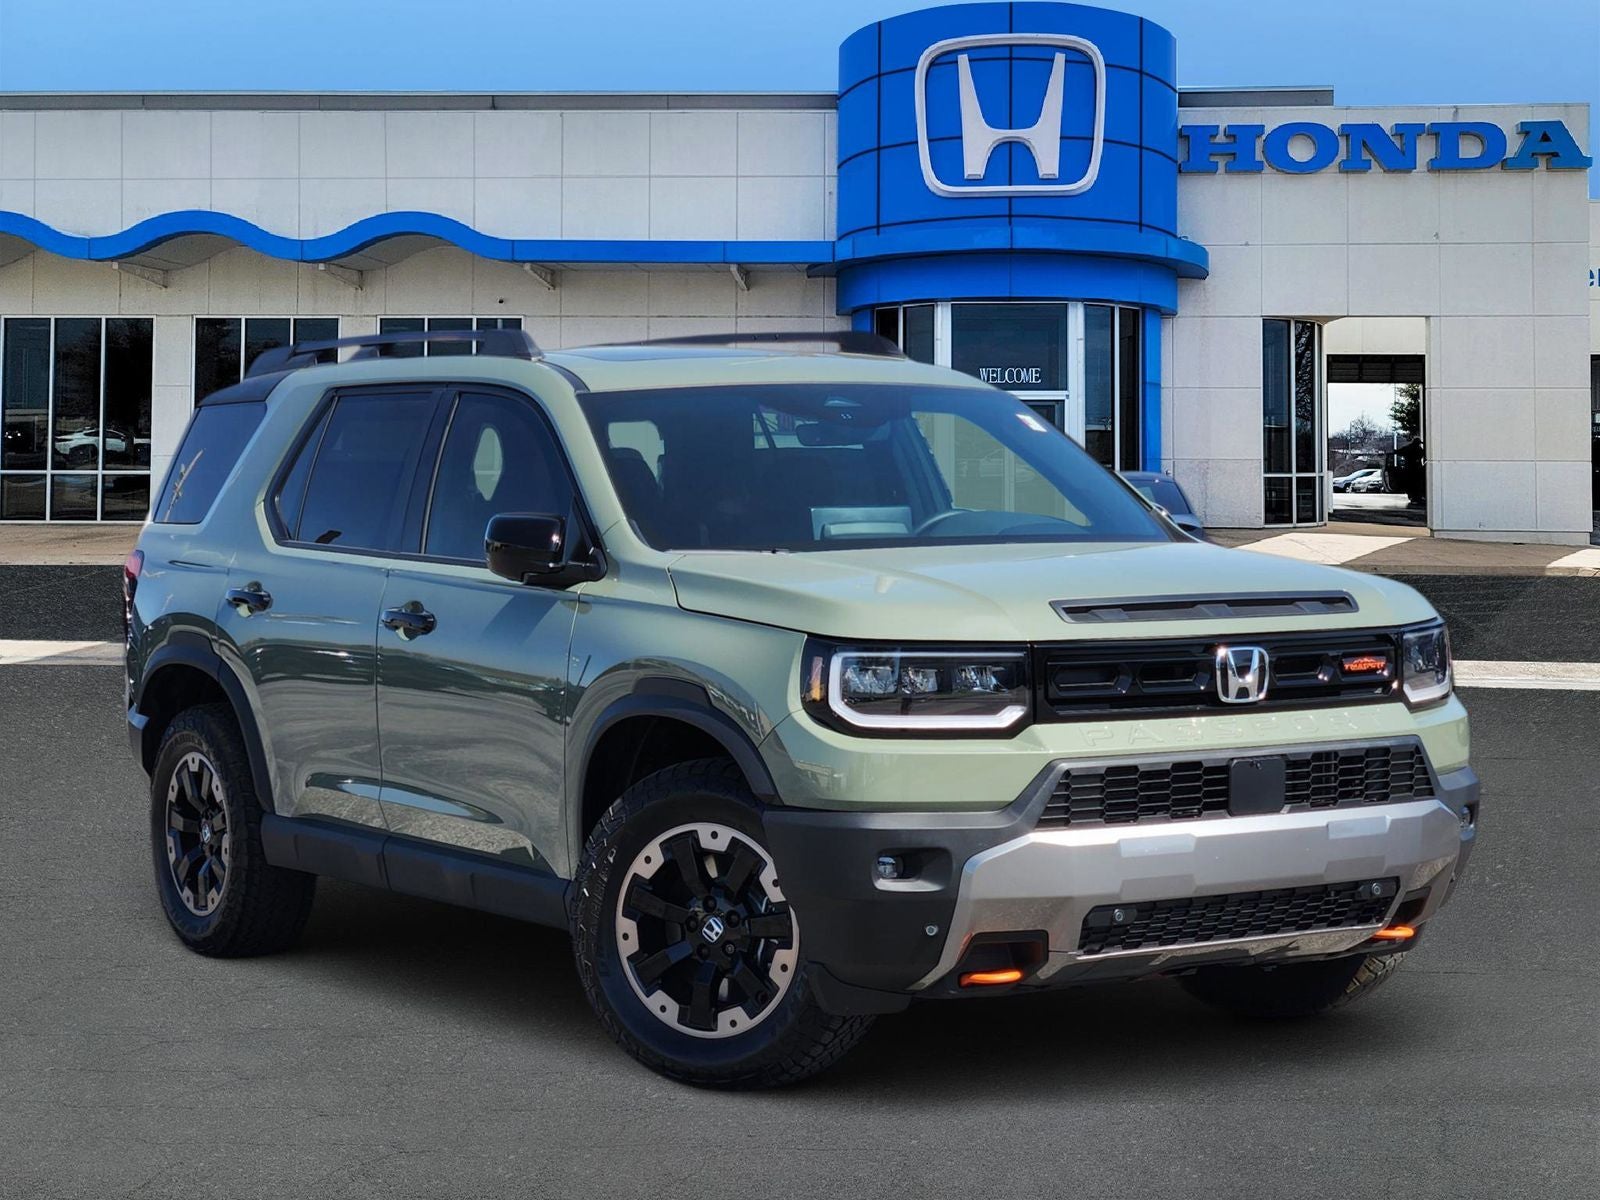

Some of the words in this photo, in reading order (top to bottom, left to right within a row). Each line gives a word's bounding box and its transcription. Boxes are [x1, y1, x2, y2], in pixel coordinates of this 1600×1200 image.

[1179, 120, 1593, 174] HONDA
[979, 367, 1042, 384] WELCOME
[1078, 709, 1383, 747] PASSPORT
